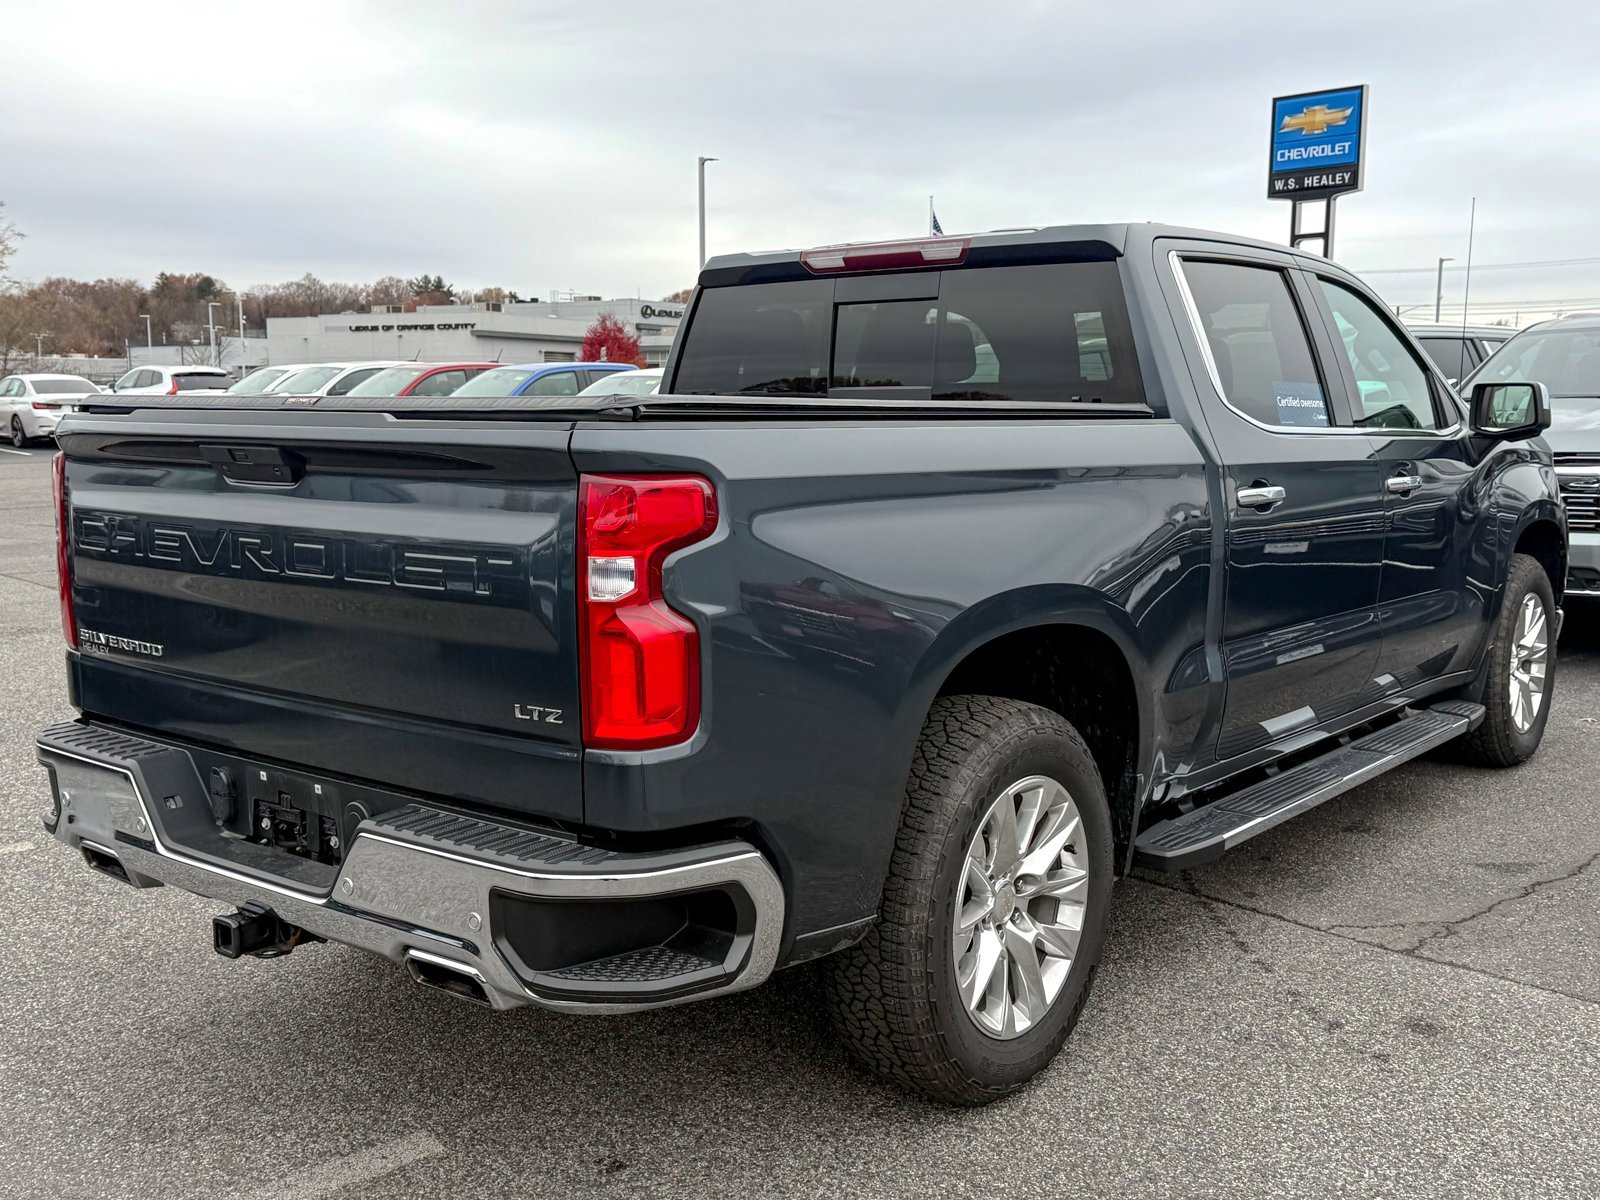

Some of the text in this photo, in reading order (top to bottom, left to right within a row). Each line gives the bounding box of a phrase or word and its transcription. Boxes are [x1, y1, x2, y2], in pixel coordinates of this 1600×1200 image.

[1276, 142, 1352, 162] CHEVROLET
[1274, 172, 1351, 191] W.S. HEALEY
[652, 309, 683, 319] LEXUS
[396, 324, 435, 332] ORANGE
[437, 323, 476, 331] COUNTY
[76, 508, 514, 595] CHEVROLET
[79, 628, 164, 656] SILVERADO
[82, 641, 110, 655] HEALEY
[514, 704, 563, 724] LTZ
